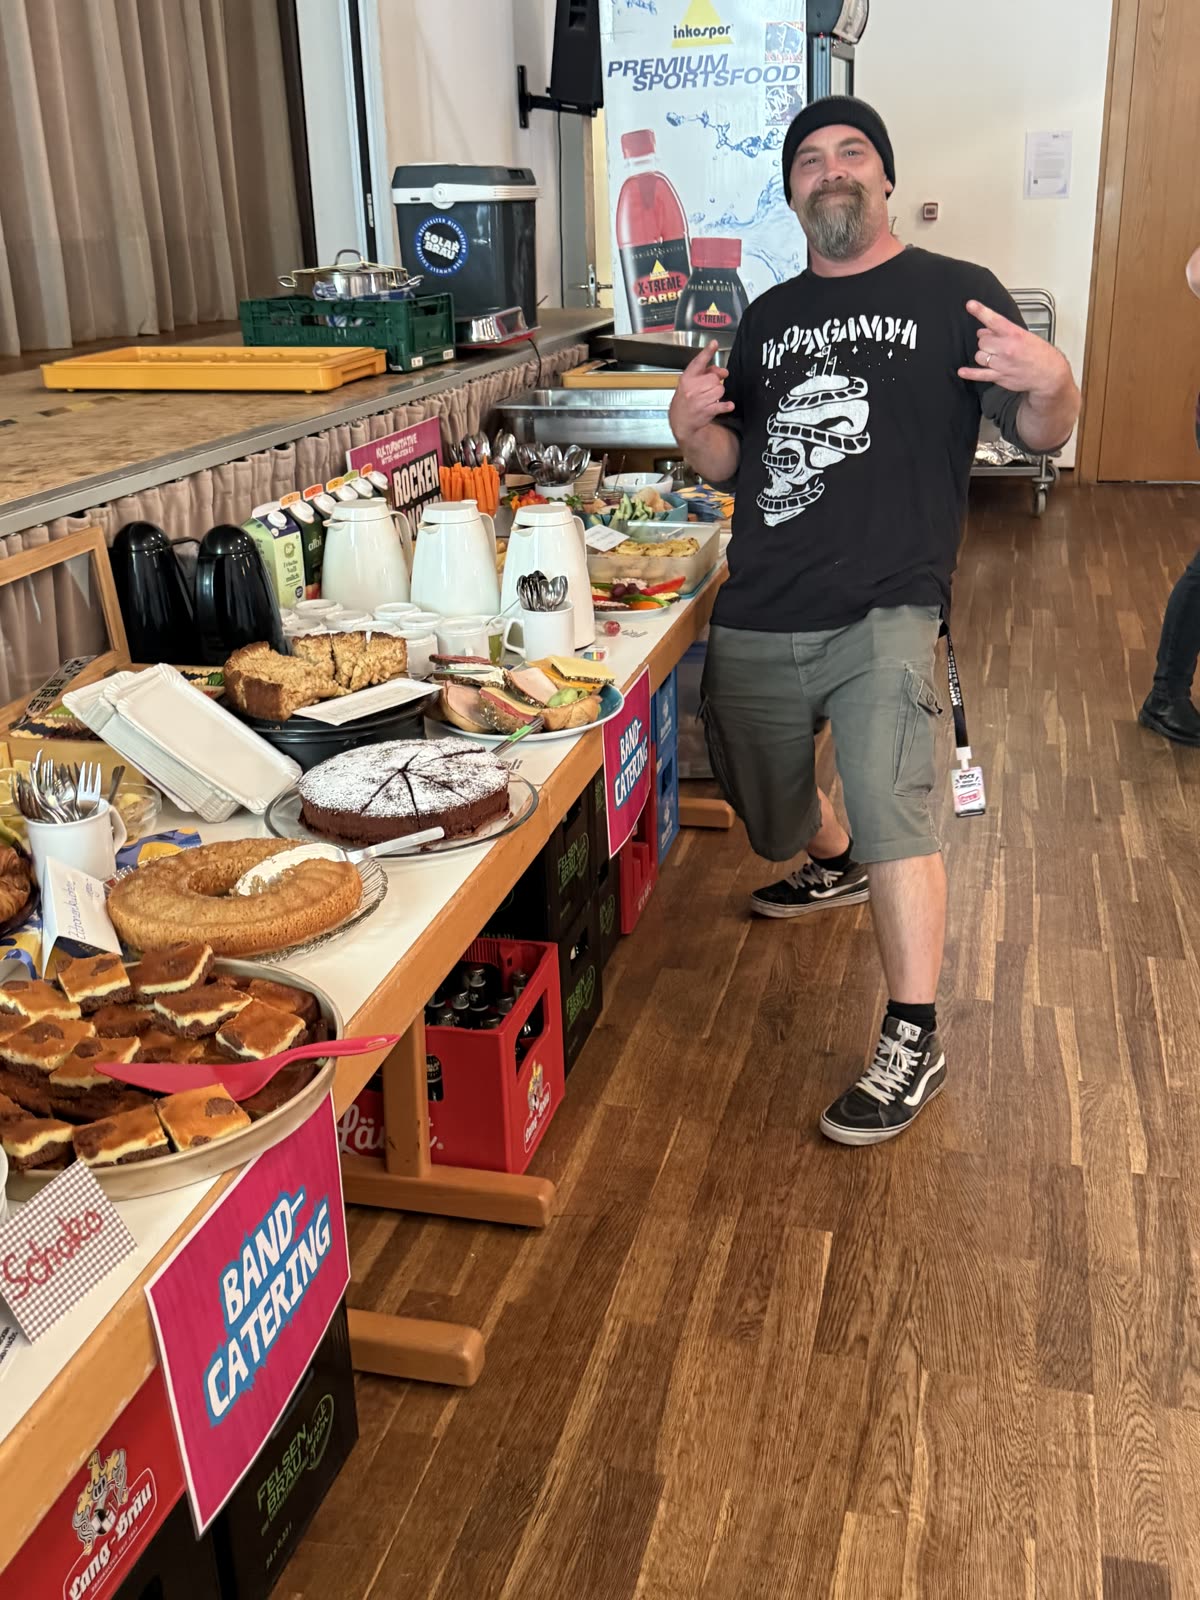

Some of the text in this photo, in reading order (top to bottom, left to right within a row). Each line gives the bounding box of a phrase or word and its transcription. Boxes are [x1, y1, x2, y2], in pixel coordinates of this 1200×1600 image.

[673, 24, 731, 40] inkospor
[607, 53, 728, 77] PREMIUM
[632, 64, 801, 92] SPORTSFOOD
[424, 231, 460, 253] SOLAR
[637, 275, 681, 294] X-TREME
[392, 453, 440, 508] ROCKEN
[619, 718, 642, 764] BAND-
[614, 736, 649, 808] CATERING
[1, 1208, 101, 1301] Schoko
[222, 1193, 304, 1326] BAND-
[206, 1202, 331, 1419] CATERING
[256, 1422, 307, 1513] FELSEN
